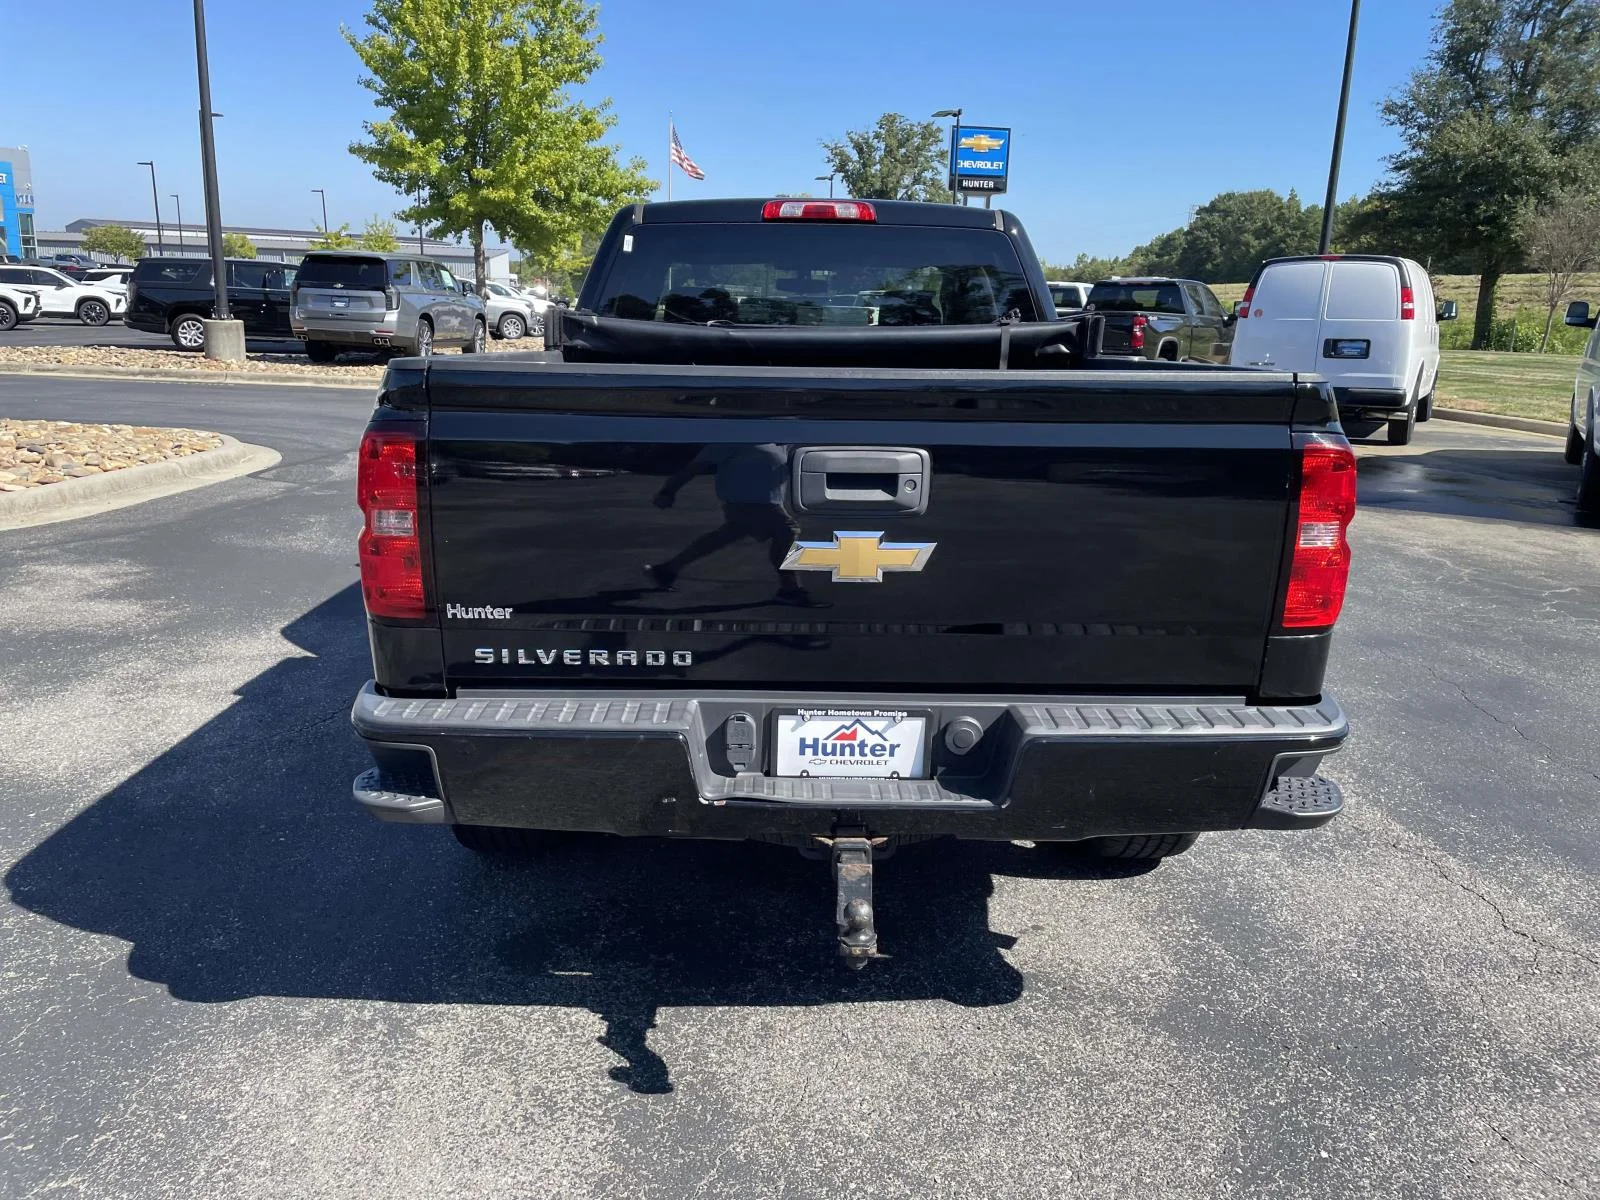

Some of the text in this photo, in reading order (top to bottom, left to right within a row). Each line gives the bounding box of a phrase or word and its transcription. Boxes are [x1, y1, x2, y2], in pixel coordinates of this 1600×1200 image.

[962, 179, 994, 188] HUNTER
[446, 603, 513, 619] Hunter
[474, 648, 692, 666] SILVERADO
[797, 708, 908, 717] Hunter Hometown Promise
[799, 737, 902, 758] Hunter
